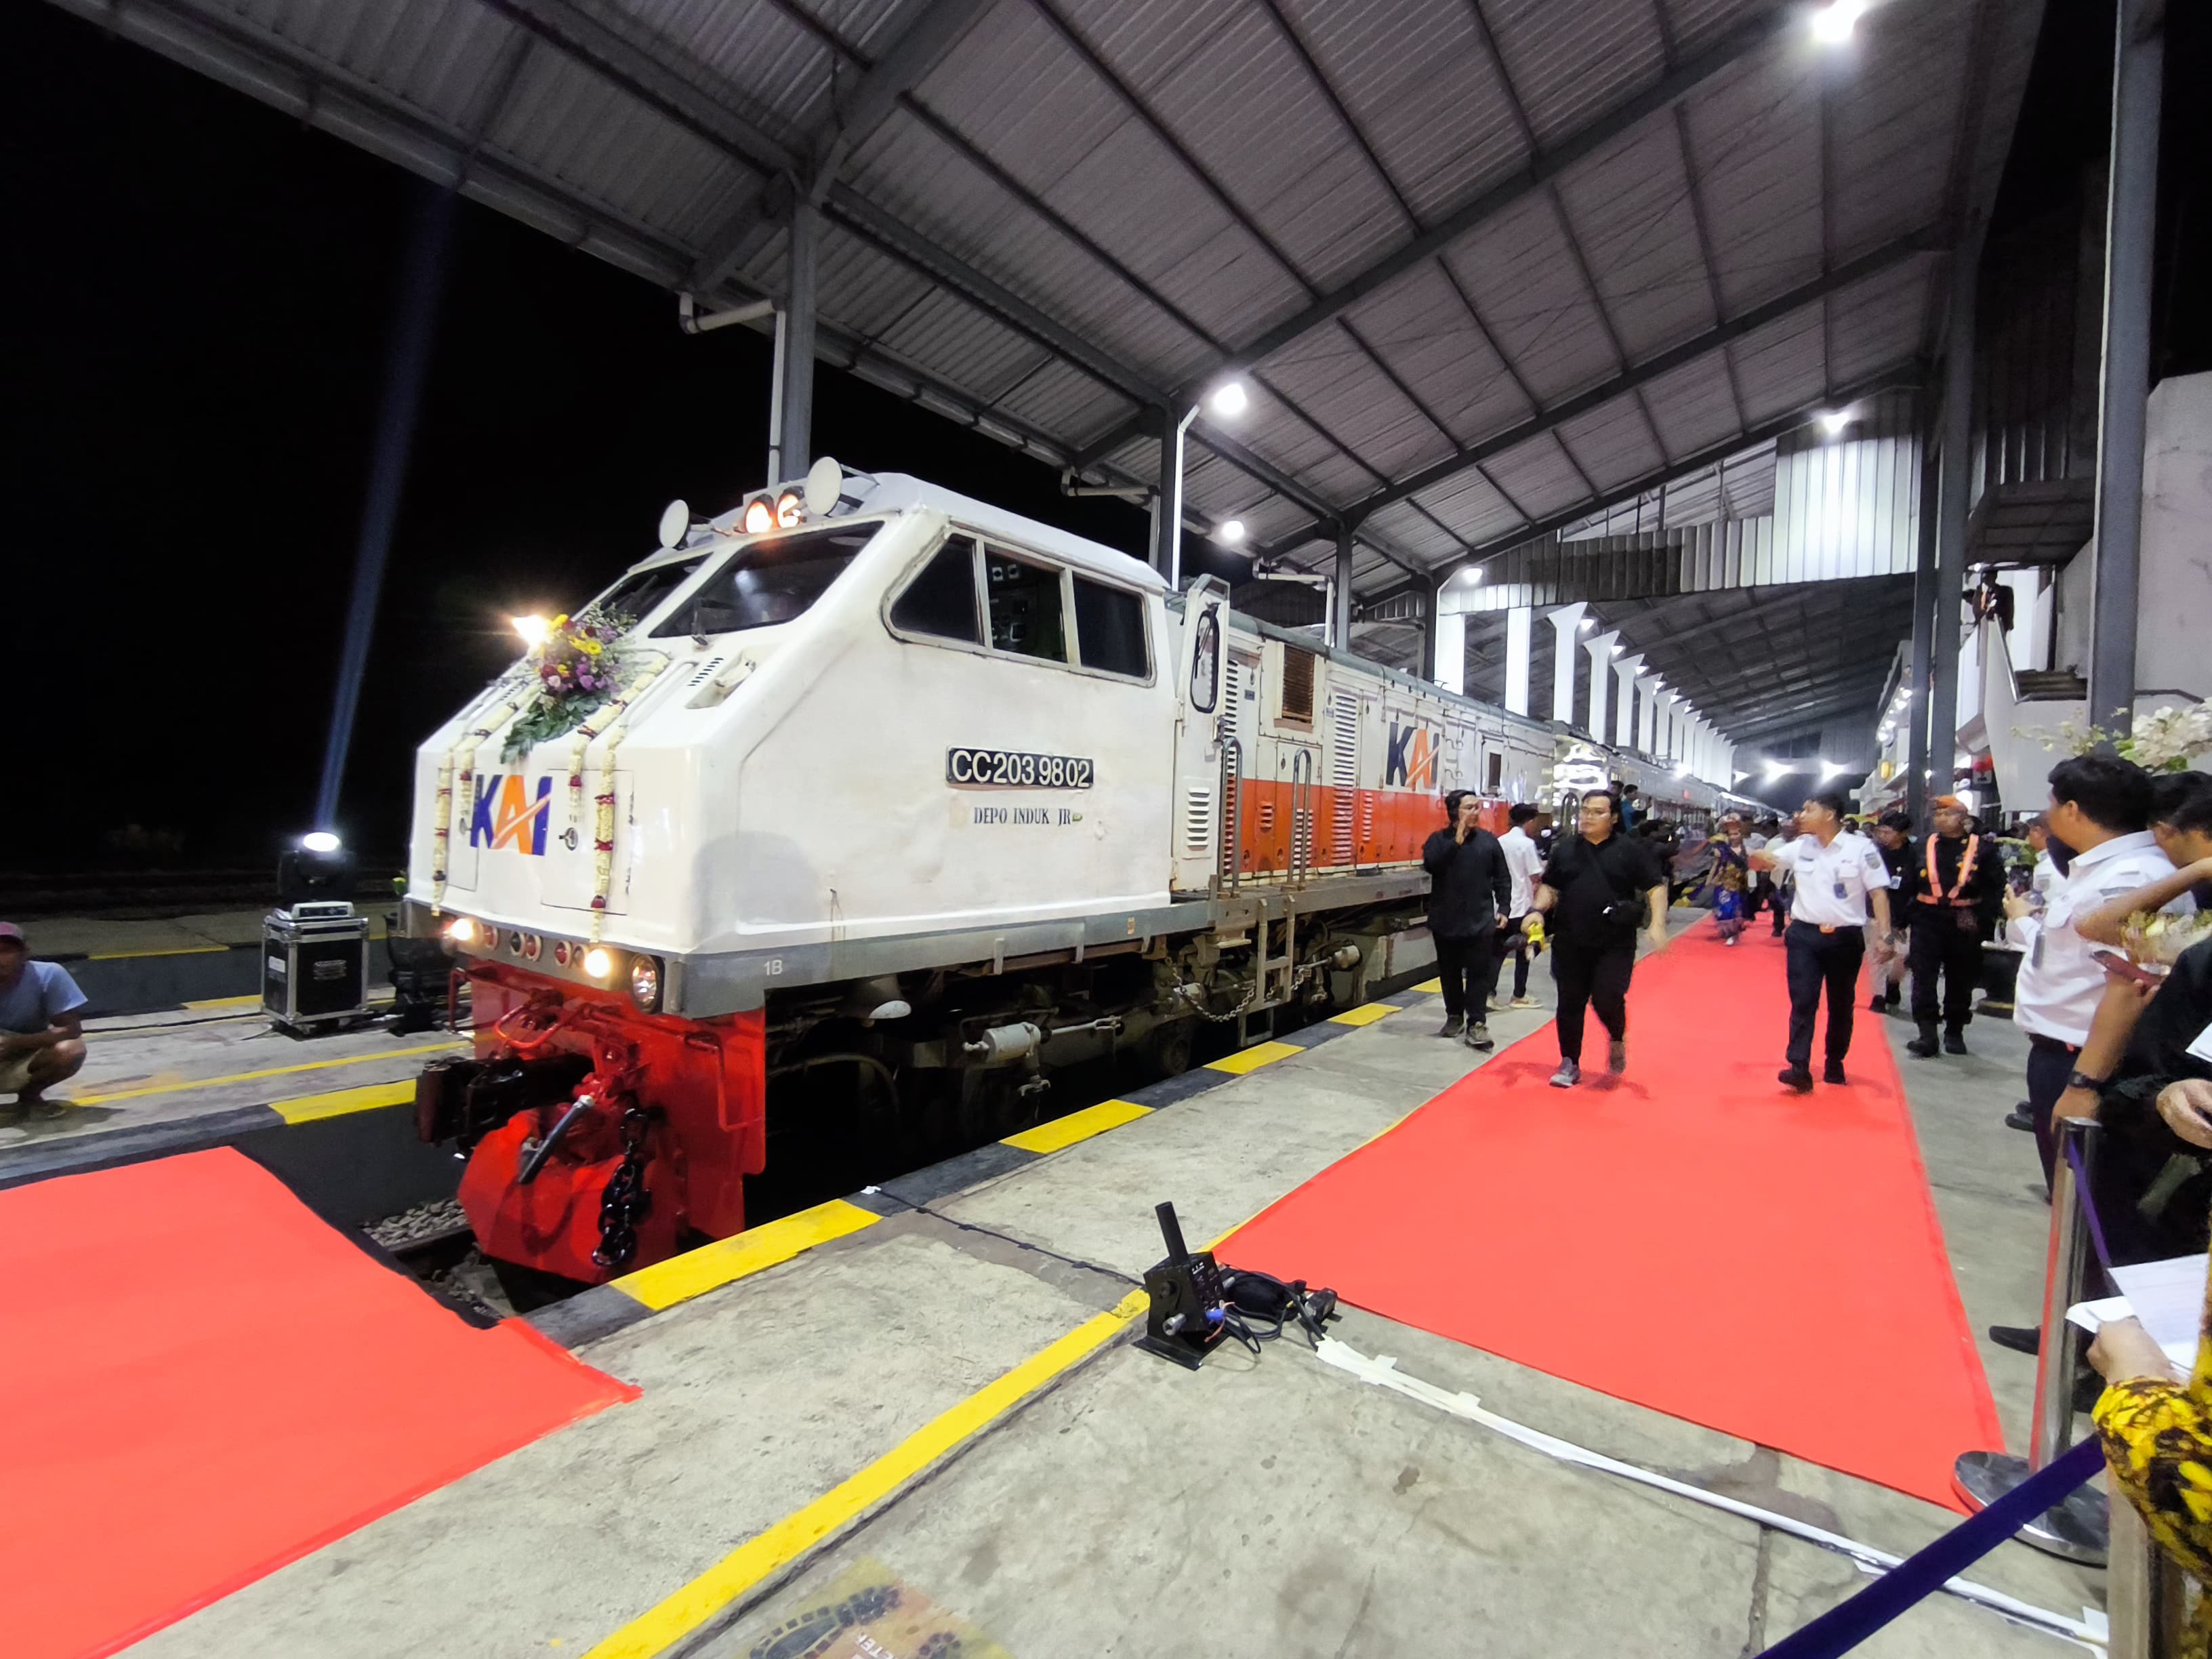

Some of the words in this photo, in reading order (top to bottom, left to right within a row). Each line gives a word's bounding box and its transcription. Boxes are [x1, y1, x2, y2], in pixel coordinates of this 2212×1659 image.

[1386, 722, 1439, 790] KAI
[470, 774, 552, 856] KAI
[974, 807, 1008, 824] DEPO
[1014, 808, 1050, 824] INDUK
[1058, 808, 1071, 826] JR
[764, 959, 783, 976] 1B
